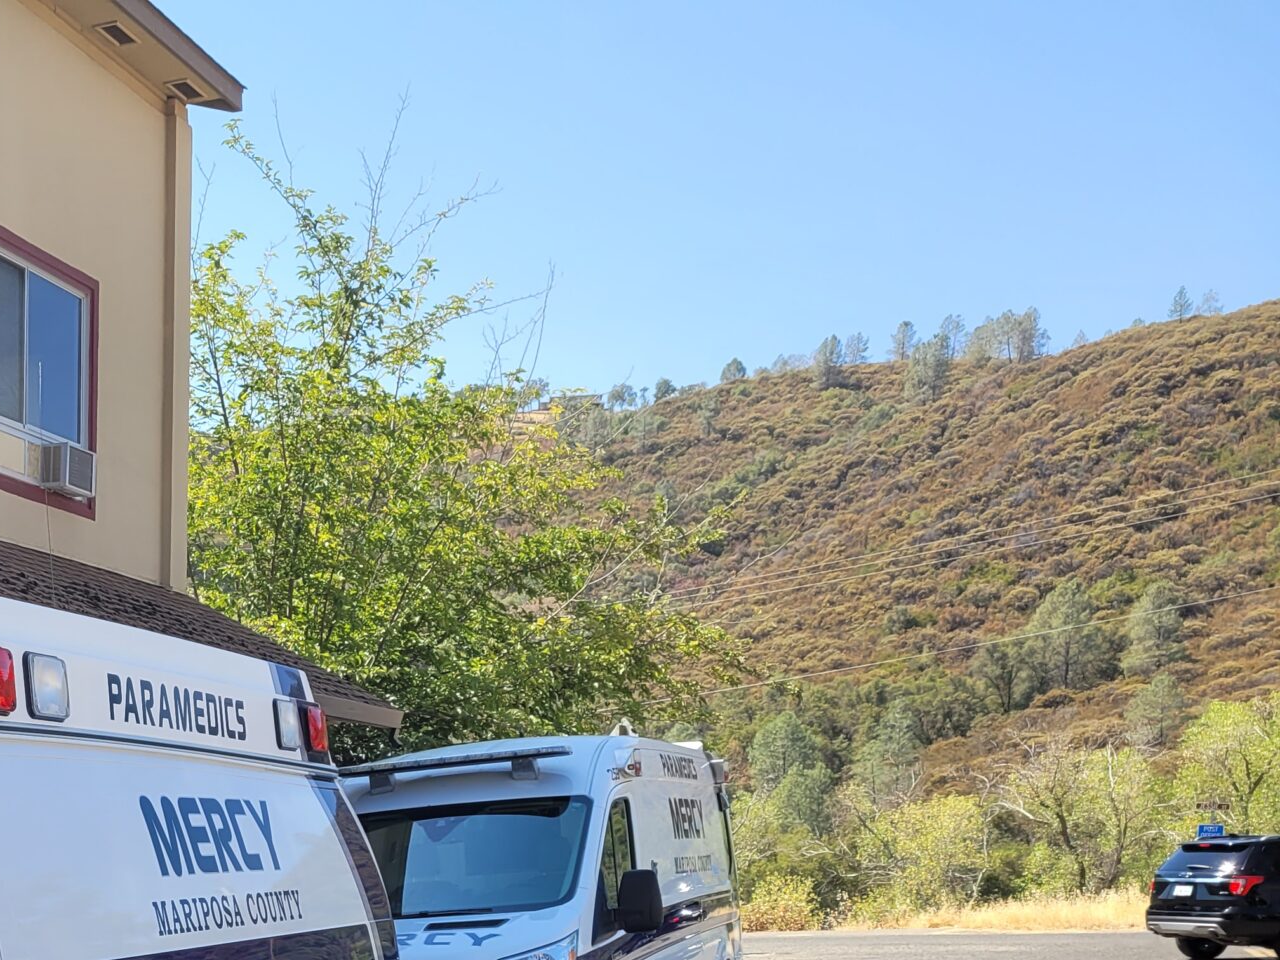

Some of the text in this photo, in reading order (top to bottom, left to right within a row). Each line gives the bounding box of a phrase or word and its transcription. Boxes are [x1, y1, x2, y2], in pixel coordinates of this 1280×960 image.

[107, 672, 247, 741] PARAMEDICS
[659, 753, 699, 780] PARAMEDICS
[139, 795, 281, 877] MERCY
[668, 797, 706, 840] MERCY
[152, 889, 303, 936] MARIPOSA COUNTY
[396, 932, 502, 947] RCY
